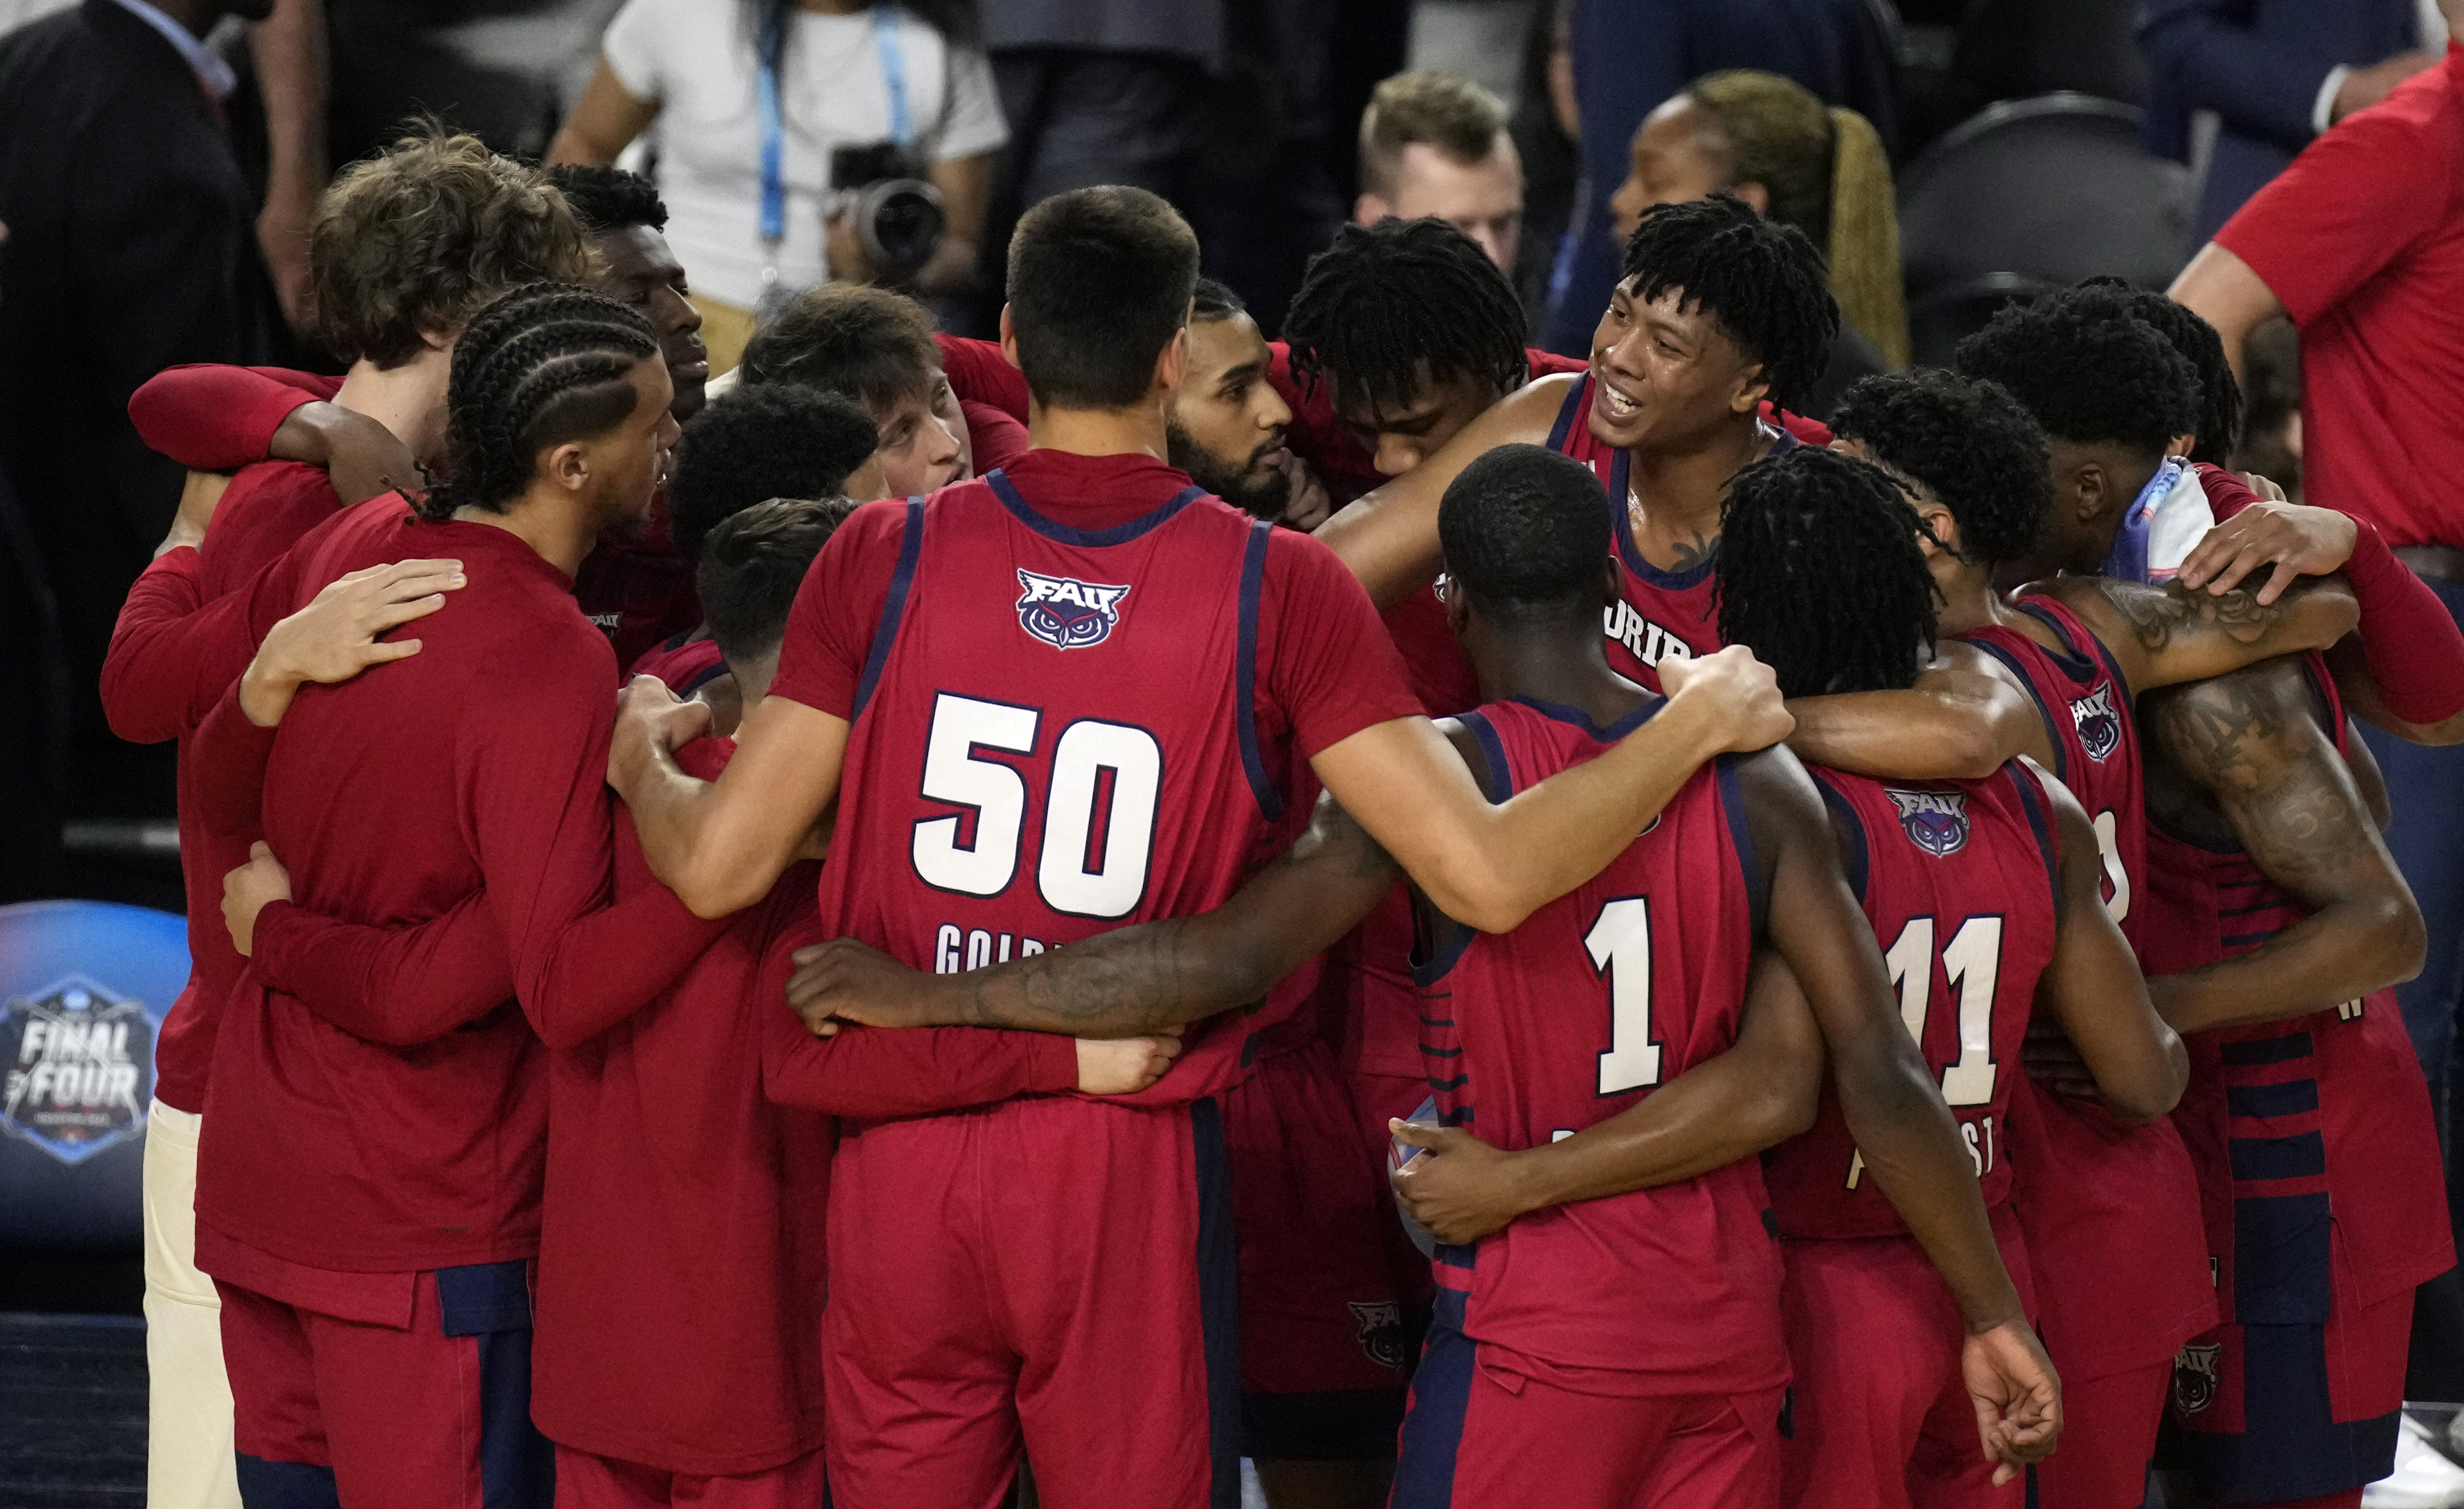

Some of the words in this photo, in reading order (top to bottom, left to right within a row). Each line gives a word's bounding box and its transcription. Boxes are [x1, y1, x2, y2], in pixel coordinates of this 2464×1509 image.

[1023, 574, 1122, 615] FAU
[911, 691, 1163, 920] 50
[1892, 792, 1963, 819] FAU
[1583, 897, 1662, 1096] 1
[1885, 916, 2002, 1106] 11
[19, 1020, 132, 1064] FINAL
[27, 1061, 139, 1107] FOUR
